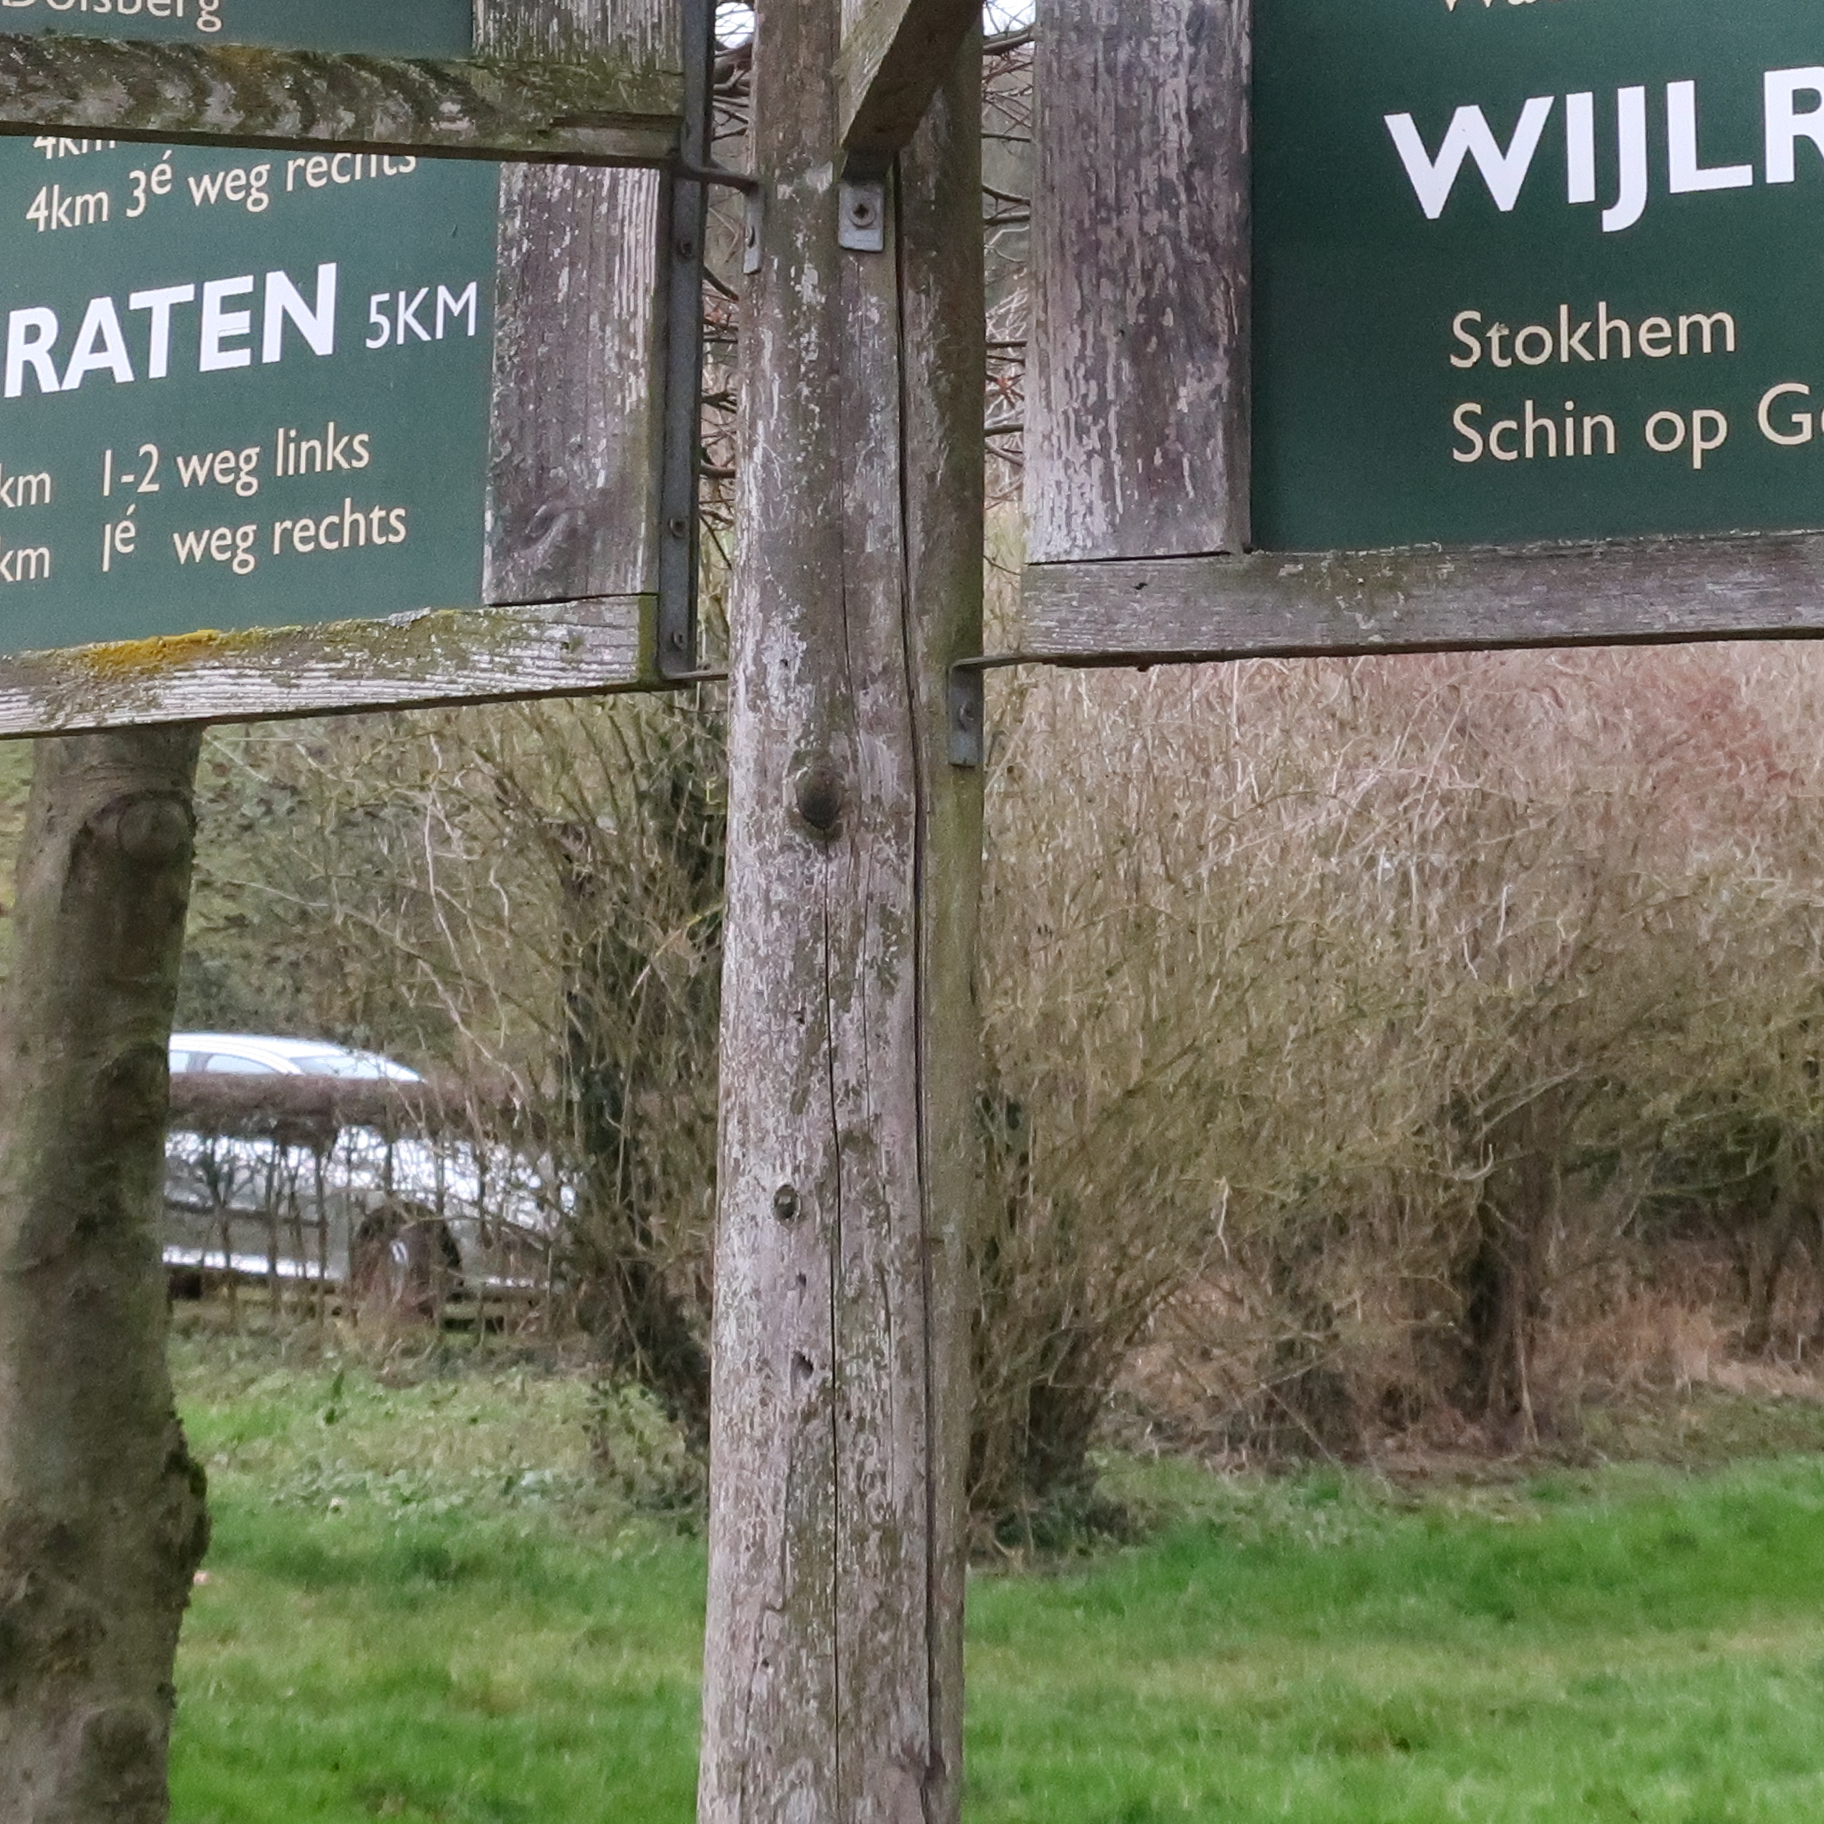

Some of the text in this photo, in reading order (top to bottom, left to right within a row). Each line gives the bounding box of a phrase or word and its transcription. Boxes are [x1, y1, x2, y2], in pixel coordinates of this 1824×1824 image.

[25, 183, 109, 233] 4km
[187, 163, 271, 213] weg
[365, 281, 477, 349] 5KM
[1450, 301, 1735, 368] Stokhem
[176, 446, 261, 497] weg
[276, 421, 370, 477] links
[1453, 399, 1615, 462] Schin
[1645, 409, 1727, 469] op
[172, 524, 258, 575] weg
[273, 497, 407, 556] rechts
